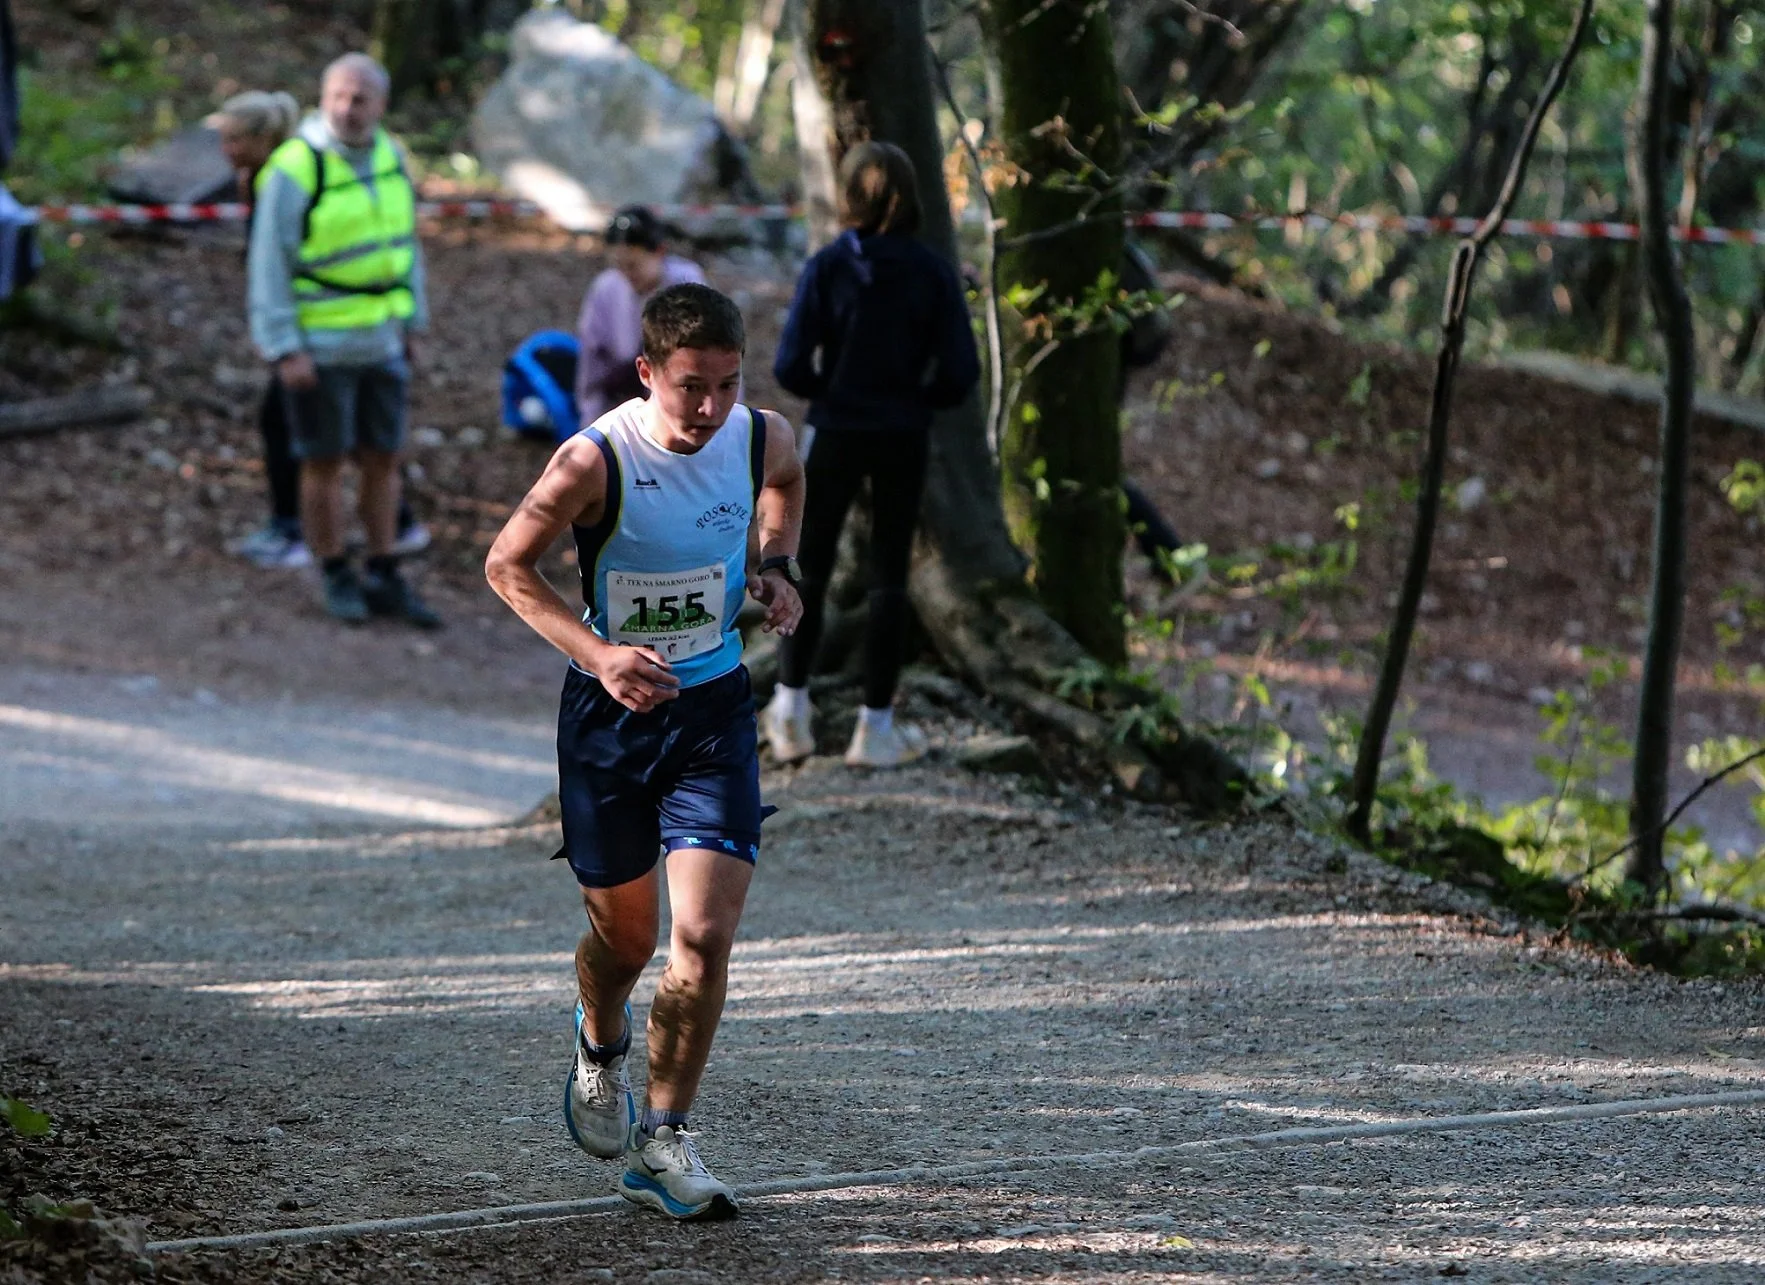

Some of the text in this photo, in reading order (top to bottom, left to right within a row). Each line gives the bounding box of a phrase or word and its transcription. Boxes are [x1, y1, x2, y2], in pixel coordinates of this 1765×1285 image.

[643, 579, 653, 587] NA
[688, 574, 710, 583] GORO
[632, 591, 705, 627] 155
[681, 617, 713, 628] GORA
